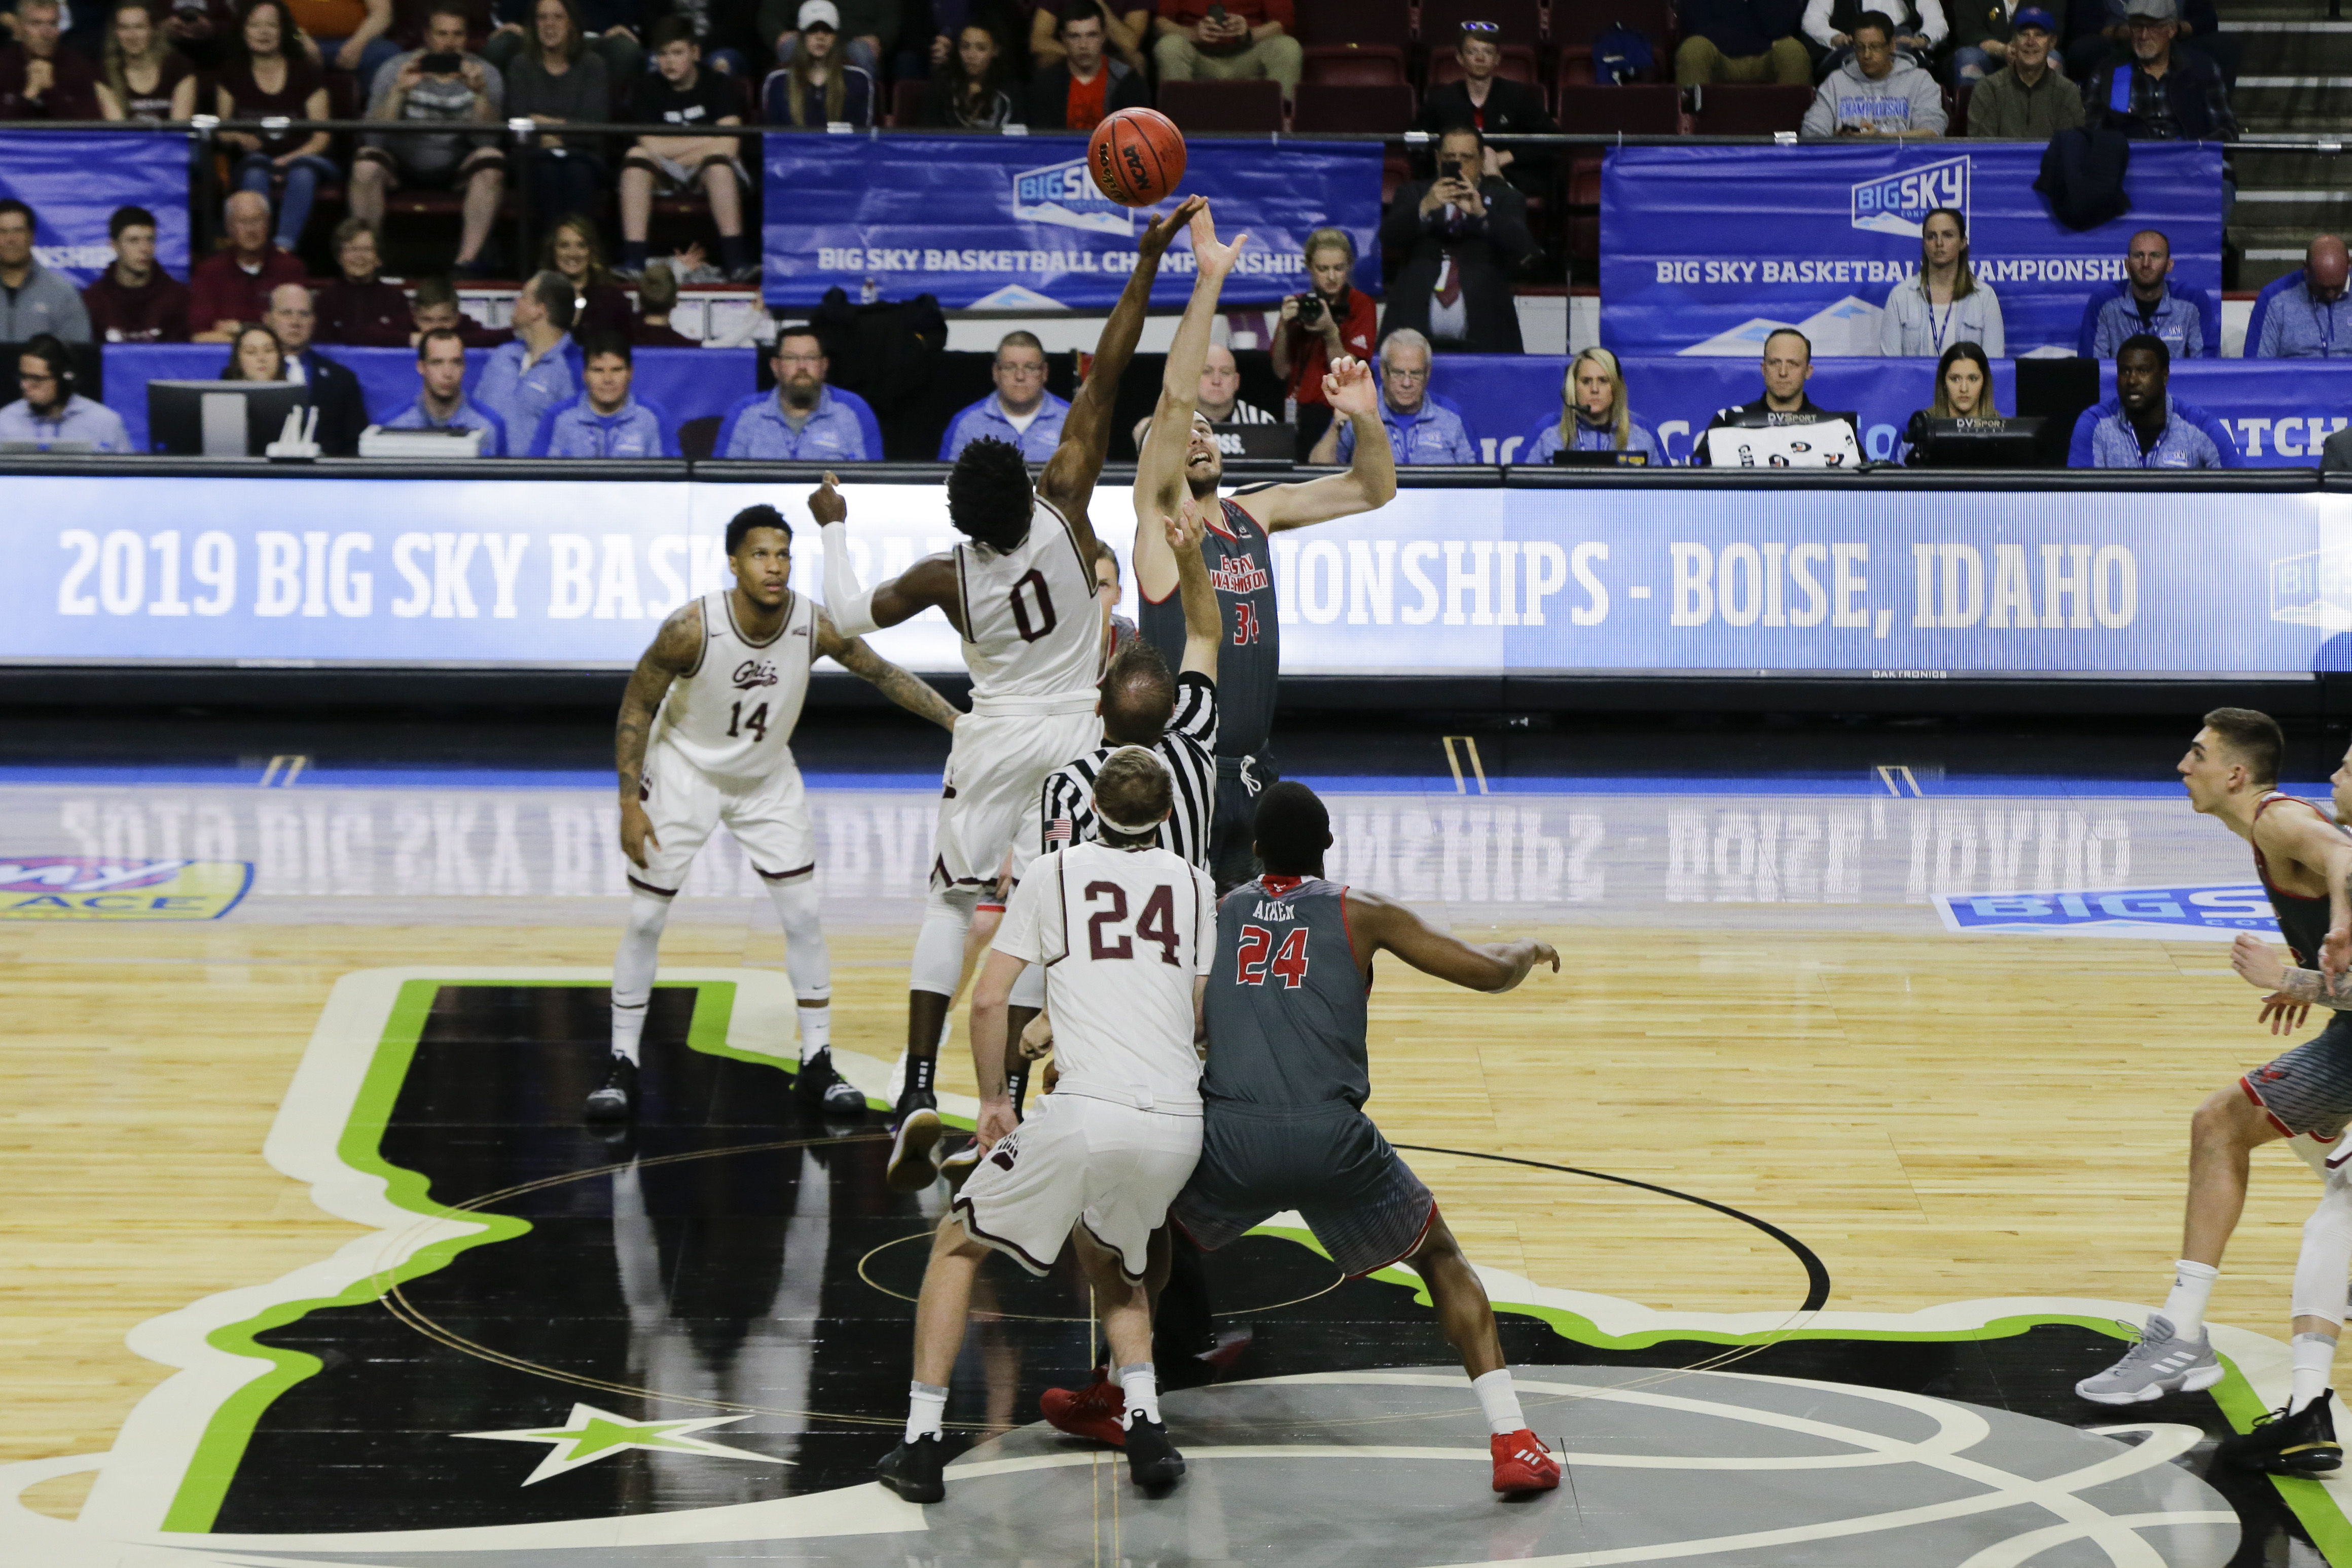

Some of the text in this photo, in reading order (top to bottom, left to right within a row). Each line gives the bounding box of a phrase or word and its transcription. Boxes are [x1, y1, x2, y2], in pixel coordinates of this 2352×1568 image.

[1123, 145, 1152, 191] NCAA
[817, 247, 862, 270] BIG
[866, 249, 919, 270] SKY
[923, 249, 1098, 272] BASKETBALL
[1656, 259, 2129, 283] BIG SKY BASKETBAL AMPIONSHI
[2219, 417, 2348, 457] TCH
[58, 529, 238, 617] 2019
[254, 530, 373, 618] BIG
[391, 532, 530, 619] SKY
[1670, 541, 1892, 639] BOISE,
[1911, 542, 2138, 629] IDAHO
[1008, 568, 1057, 642] 0
[732, 660, 778, 690] Griz
[1872, 670, 1947, 679] DAKTRONICS
[727, 701, 769, 742] 14
[1083, 880, 1181, 968] 24
[1236, 925, 1310, 990] 24
